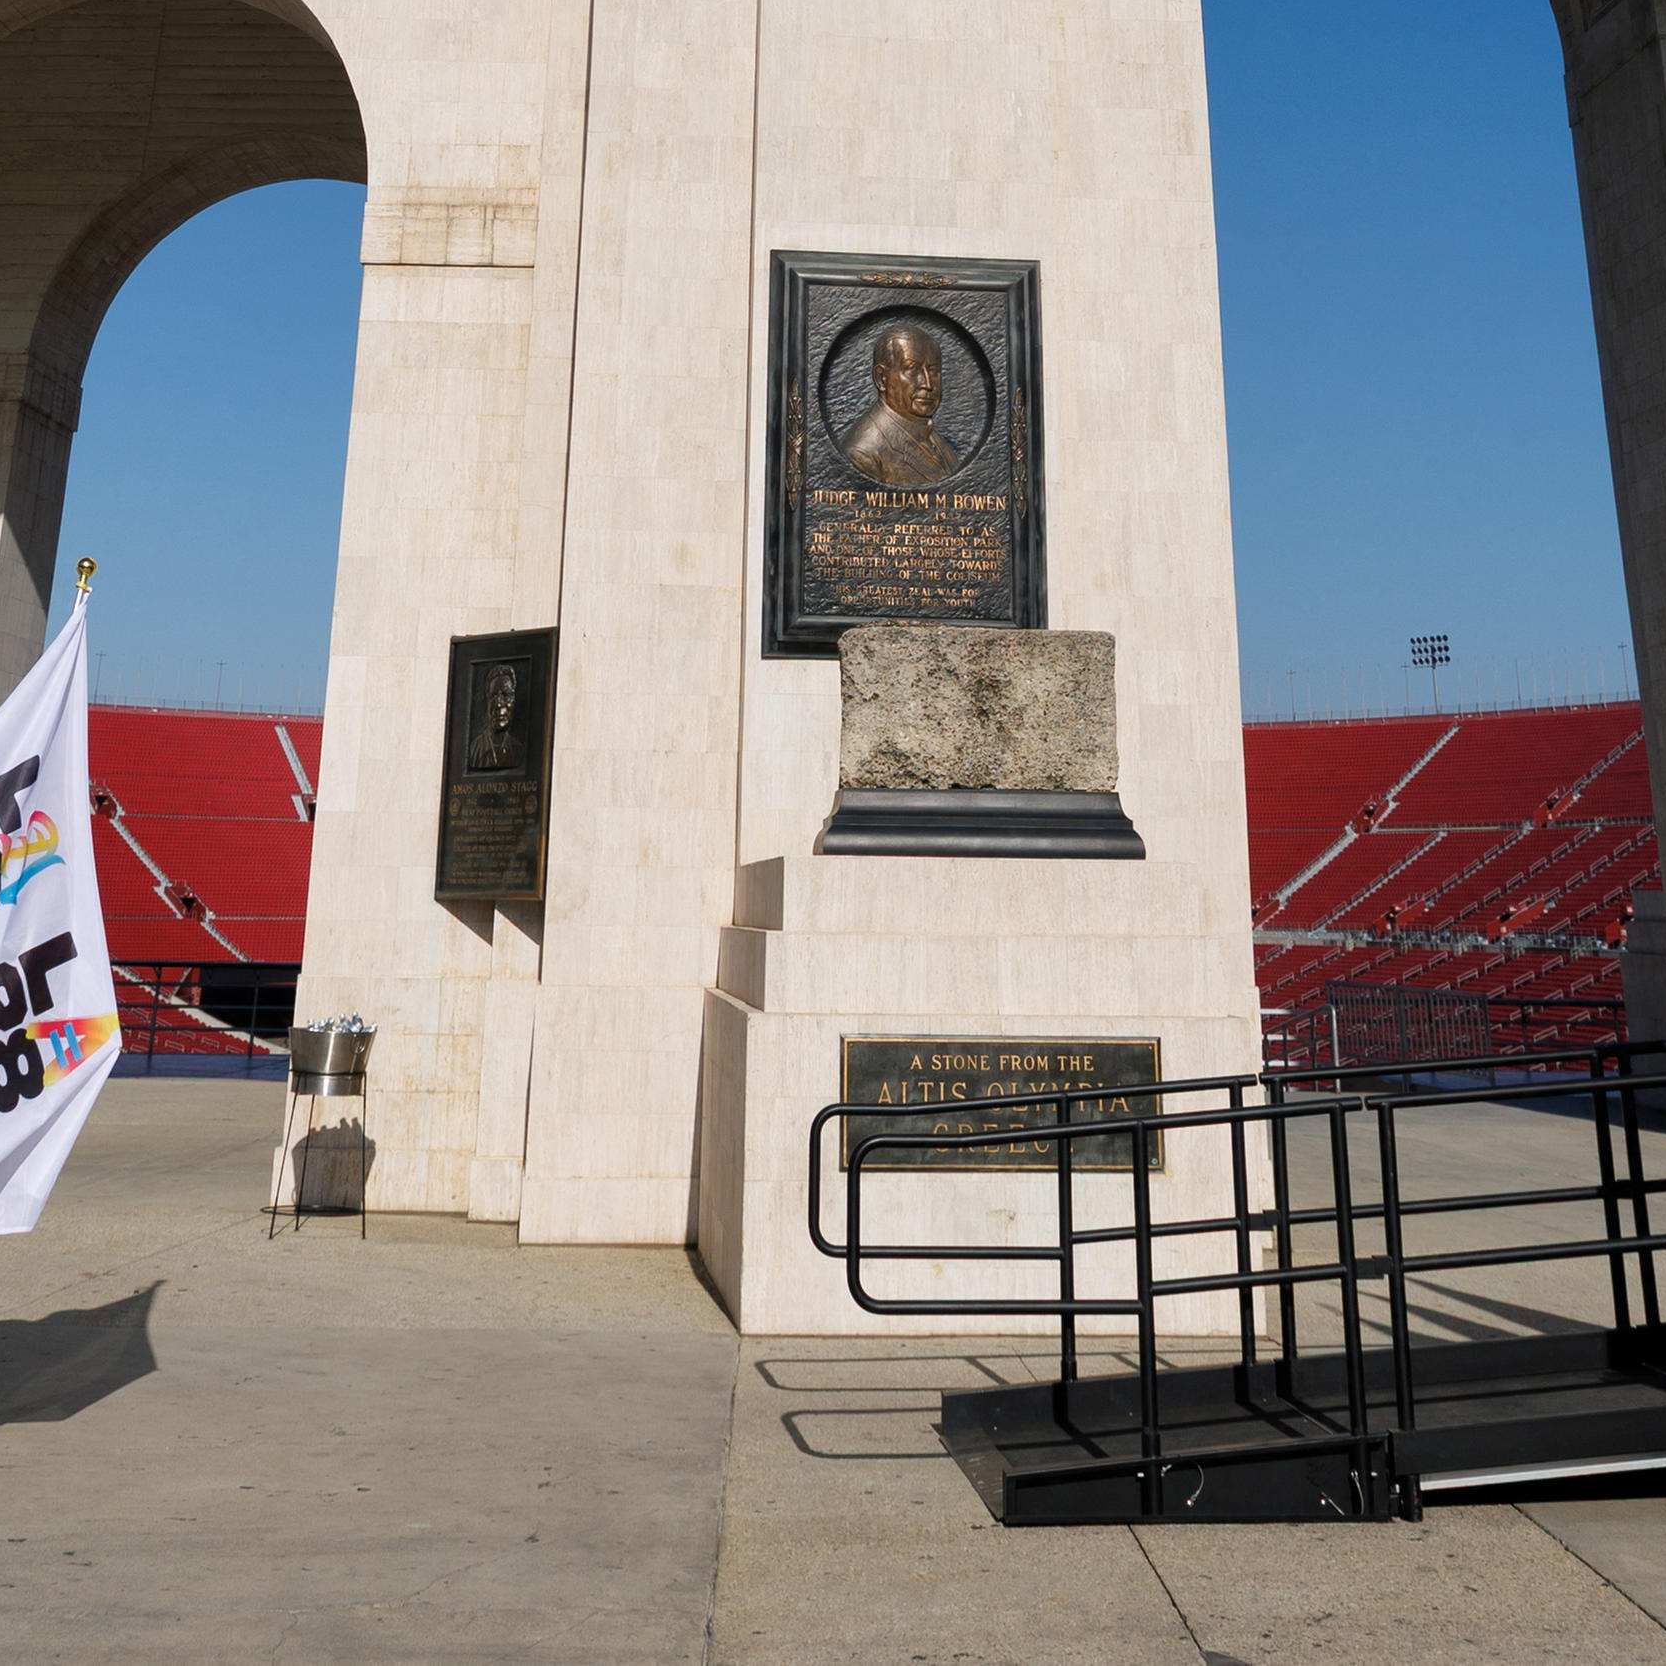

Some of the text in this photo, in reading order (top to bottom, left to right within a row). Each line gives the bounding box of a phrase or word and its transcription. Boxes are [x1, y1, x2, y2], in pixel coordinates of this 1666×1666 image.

[809, 490, 857, 506] JUDGE
[866, 492, 929, 509] WILLIAM
[953, 494, 1007, 511] BOWEN
[819, 522, 997, 537] GENERALLY REFERRED TO AS
[813, 533, 1003, 548] THE FATHER OF EXPOSITION PARK
[808, 544, 1008, 559] AND ONE OF THOSE WHOSE EFFORTS
[811, 556, 1004, 571] CONTRIBUTED LARGELY TOWARDS
[816, 567, 1001, 582] THE BUILDING OF THE COLISEUM
[857, 586, 903, 596] GREATEST
[908, 587, 933, 596] ZEAL
[937, 587, 958, 597] WAS
[962, 588, 981, 598] FOR
[840, 595, 977, 608] OPPORTUNITIES FOR YOUTH
[477, 782, 508, 794] ALONZO
[512, 781, 538, 793] STAGG
[910, 1054, 1094, 1072] A STONE FROM THE
[932, 1122, 1076, 1154] GREEC
